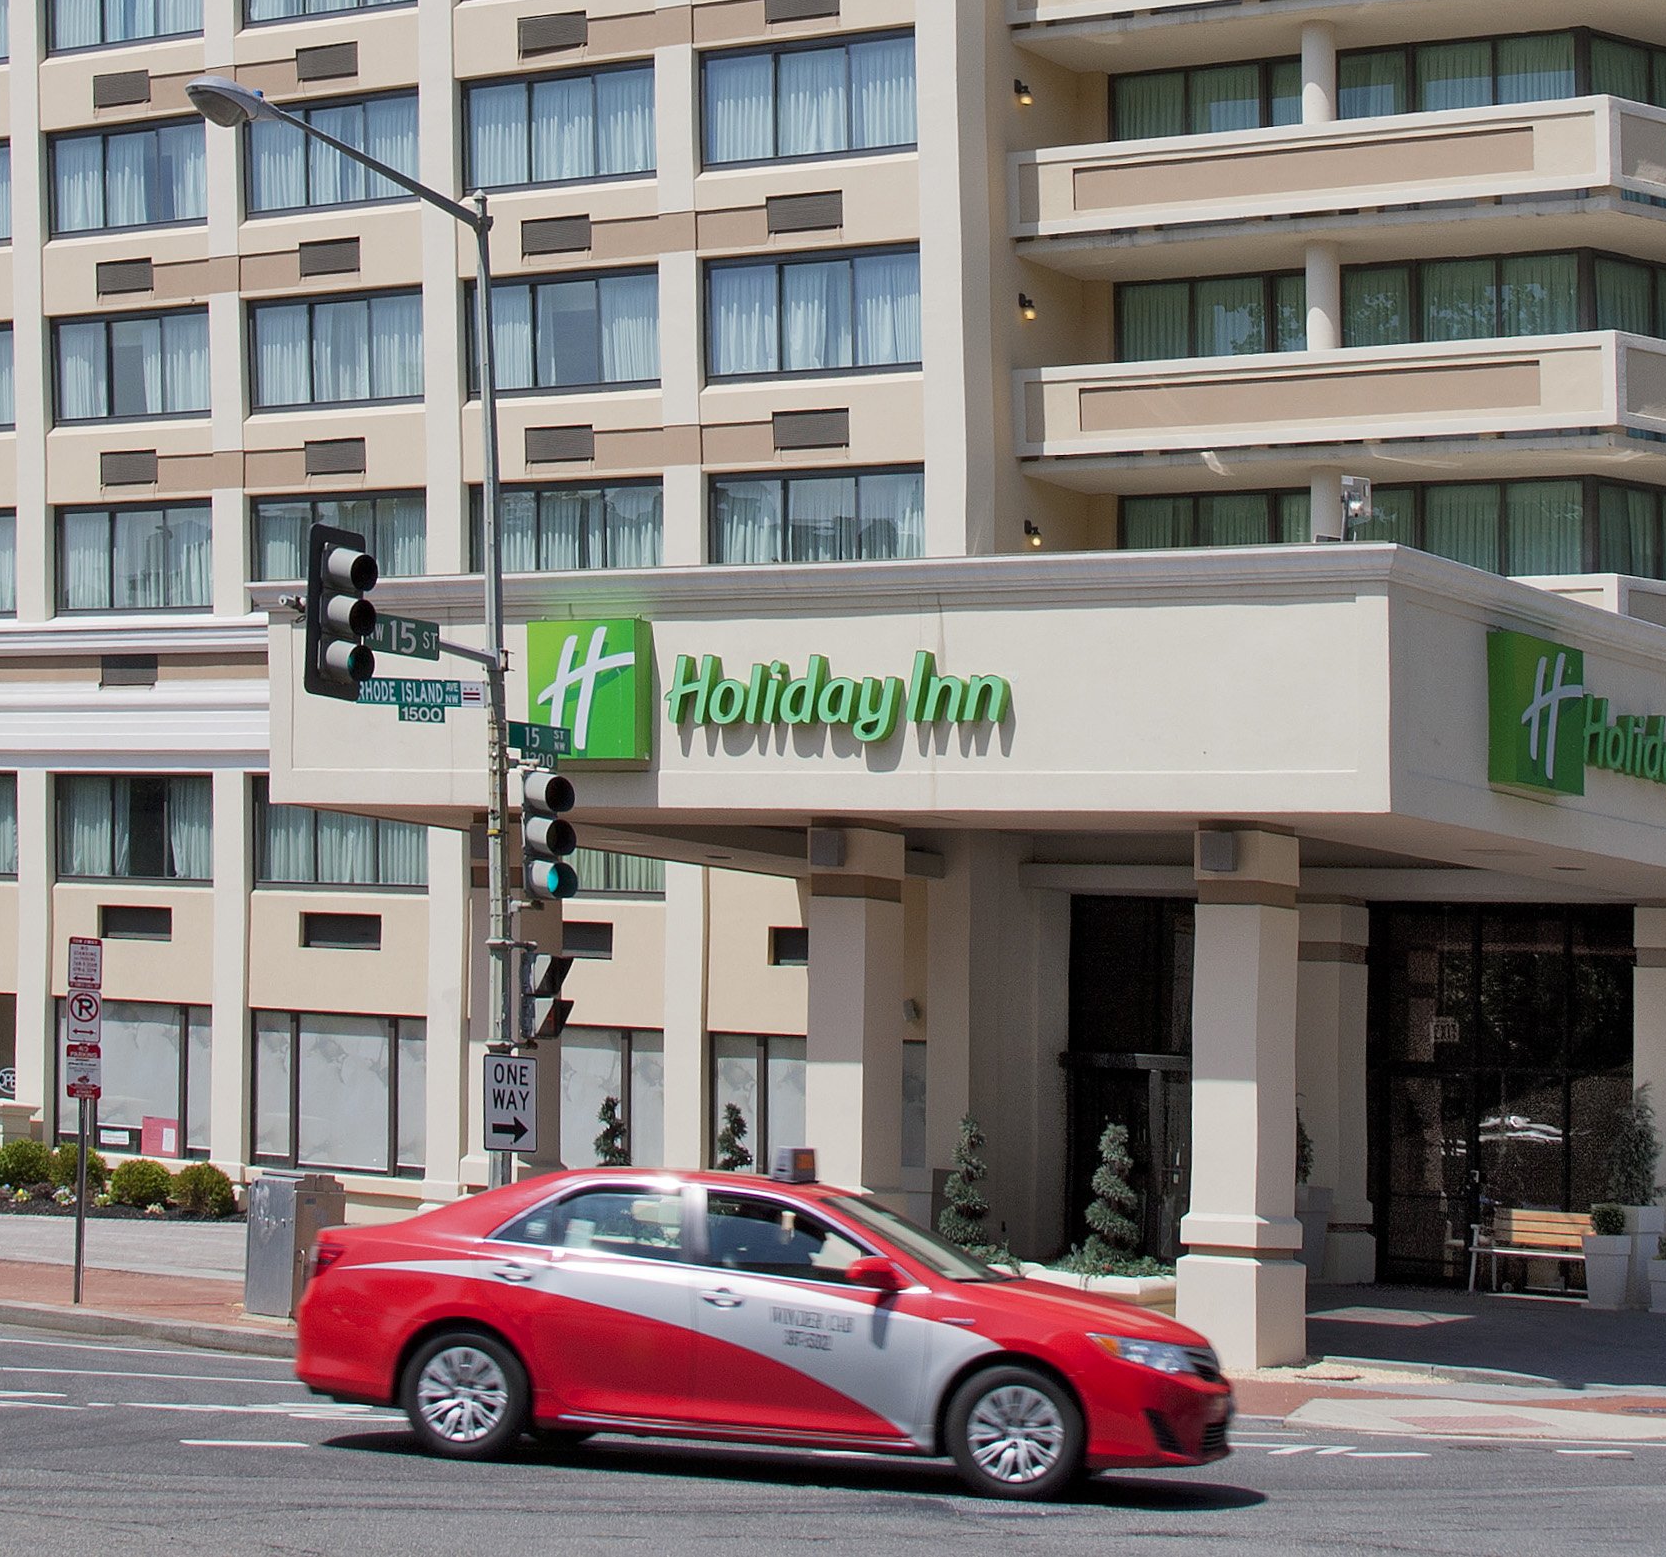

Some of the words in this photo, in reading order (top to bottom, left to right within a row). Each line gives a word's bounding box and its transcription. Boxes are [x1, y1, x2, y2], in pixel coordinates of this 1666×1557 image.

[390, 619, 417, 655] 15
[422, 631, 438, 650] ST
[358, 680, 397, 701] RHODE
[401, 681, 443, 703] ISLAND
[445, 682, 459, 692] AVE
[445, 693, 459, 704] NW
[664, 654, 904, 742] Holiday
[905, 650, 1011, 723] Inn
[401, 706, 442, 722] 1500
[525, 727, 540, 748] 15
[553, 730, 564, 740] ST
[554, 741, 566, 751] NW
[494, 1063, 529, 1086] ONE
[492, 1088, 530, 1111] WAY
